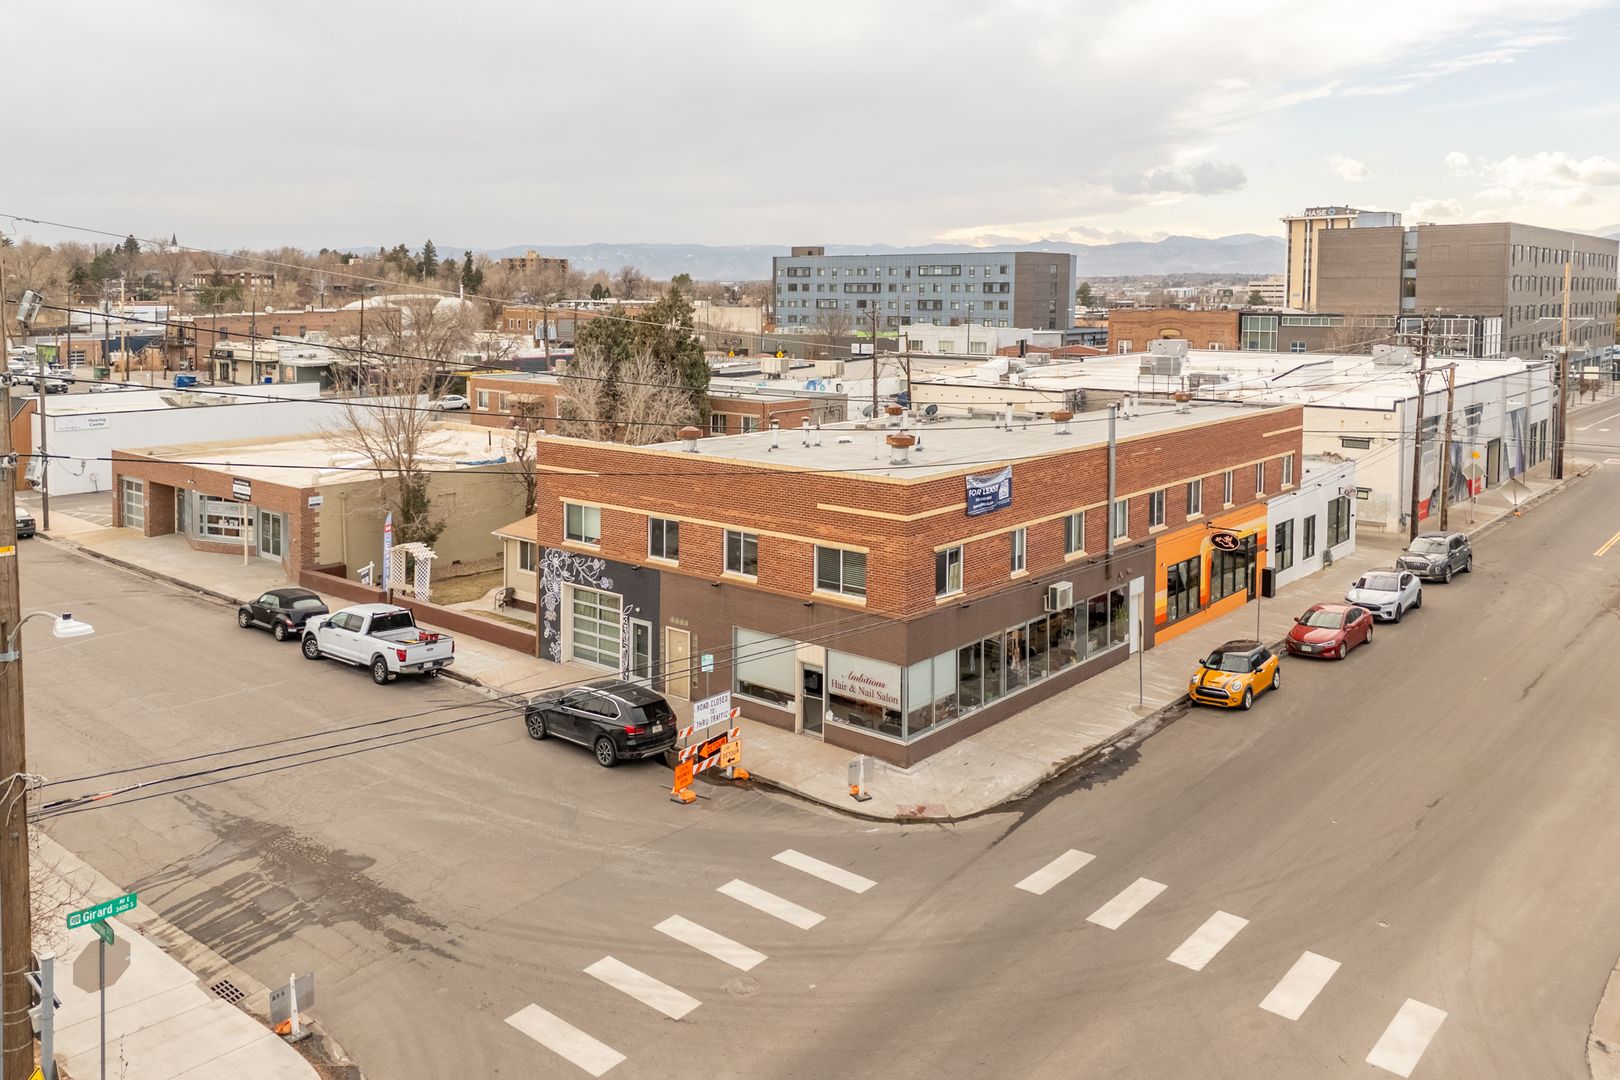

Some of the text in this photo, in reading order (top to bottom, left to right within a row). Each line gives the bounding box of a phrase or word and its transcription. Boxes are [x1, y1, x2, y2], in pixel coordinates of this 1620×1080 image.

[969, 485, 999, 497] FOR LEASE
[841, 670, 887, 688] Ambitions
[831, 679, 899, 705] Hair & Nail Salon
[697, 695, 728, 712] ROAD CLOSED
[696, 710, 729, 729] THRU TRAFFIC
[707, 737, 727, 752] DETOUR
[82, 904, 113, 922] Girard
